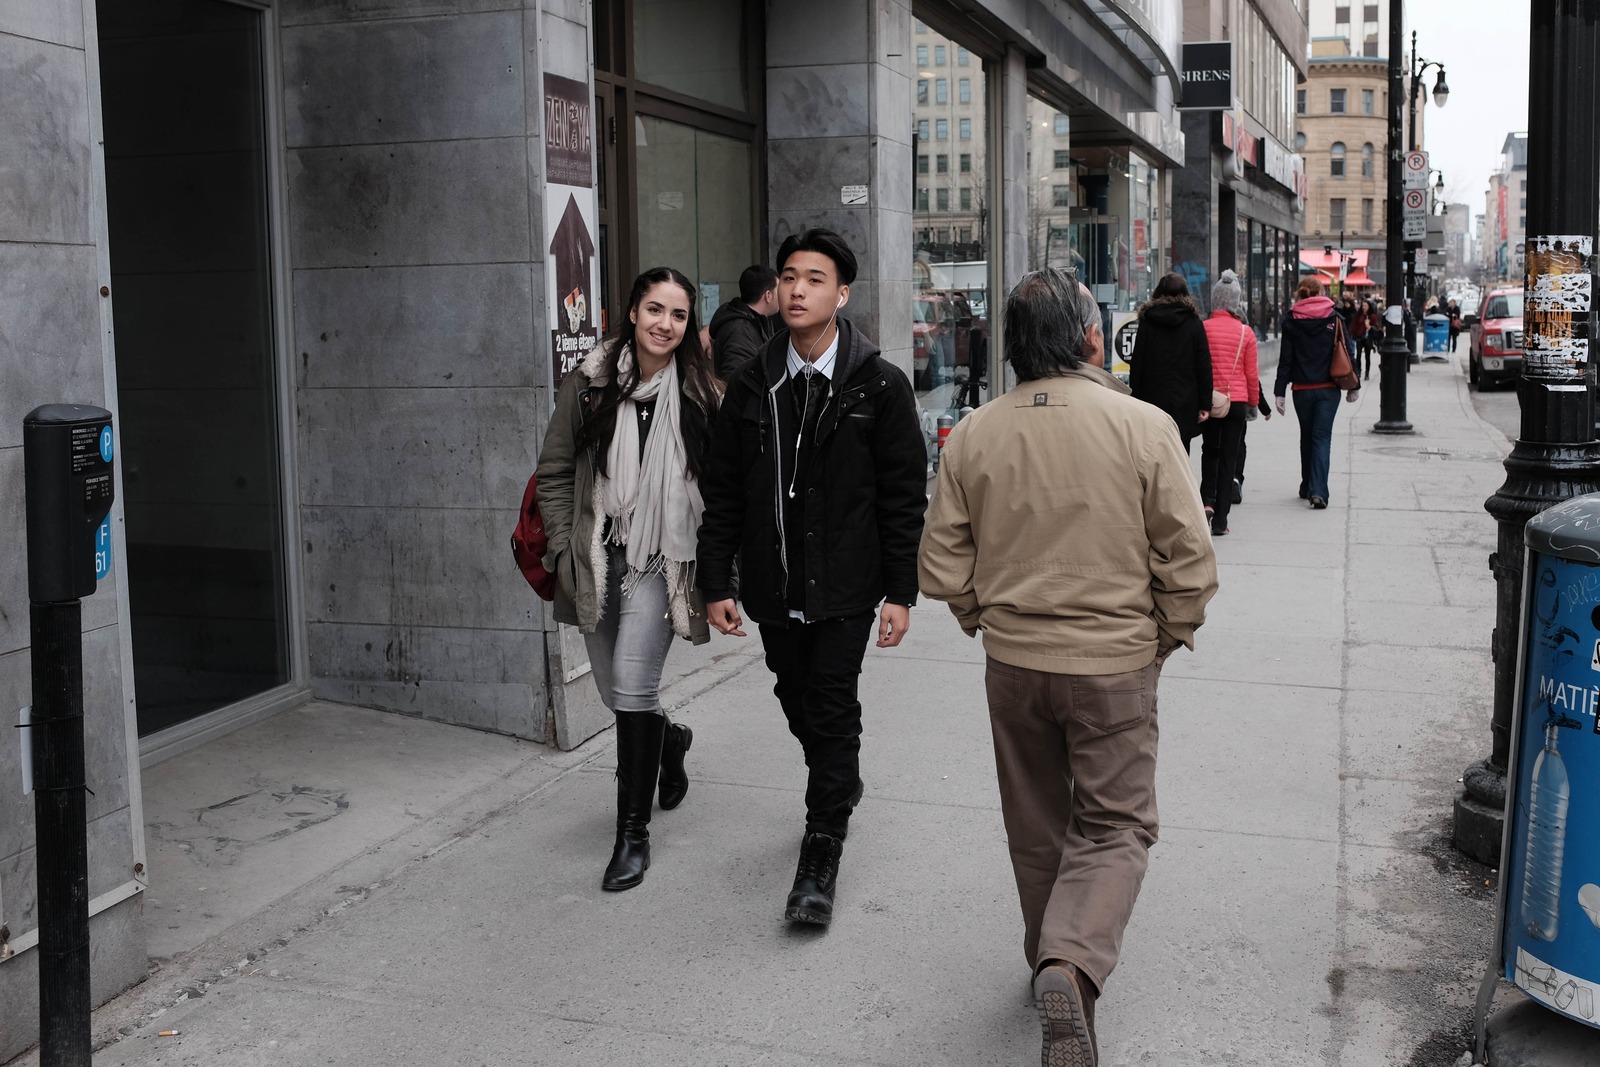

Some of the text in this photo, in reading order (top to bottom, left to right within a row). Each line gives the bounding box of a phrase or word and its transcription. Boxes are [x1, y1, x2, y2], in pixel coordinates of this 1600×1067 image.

[546, 96, 592, 152] ZEN YA
[556, 334, 562, 352] 2
[579, 332, 596, 352] étage
[561, 354, 567, 372] 2
[104, 432, 110, 456] P
[100, 524, 108, 546] F
[96, 551, 106, 572] 61
